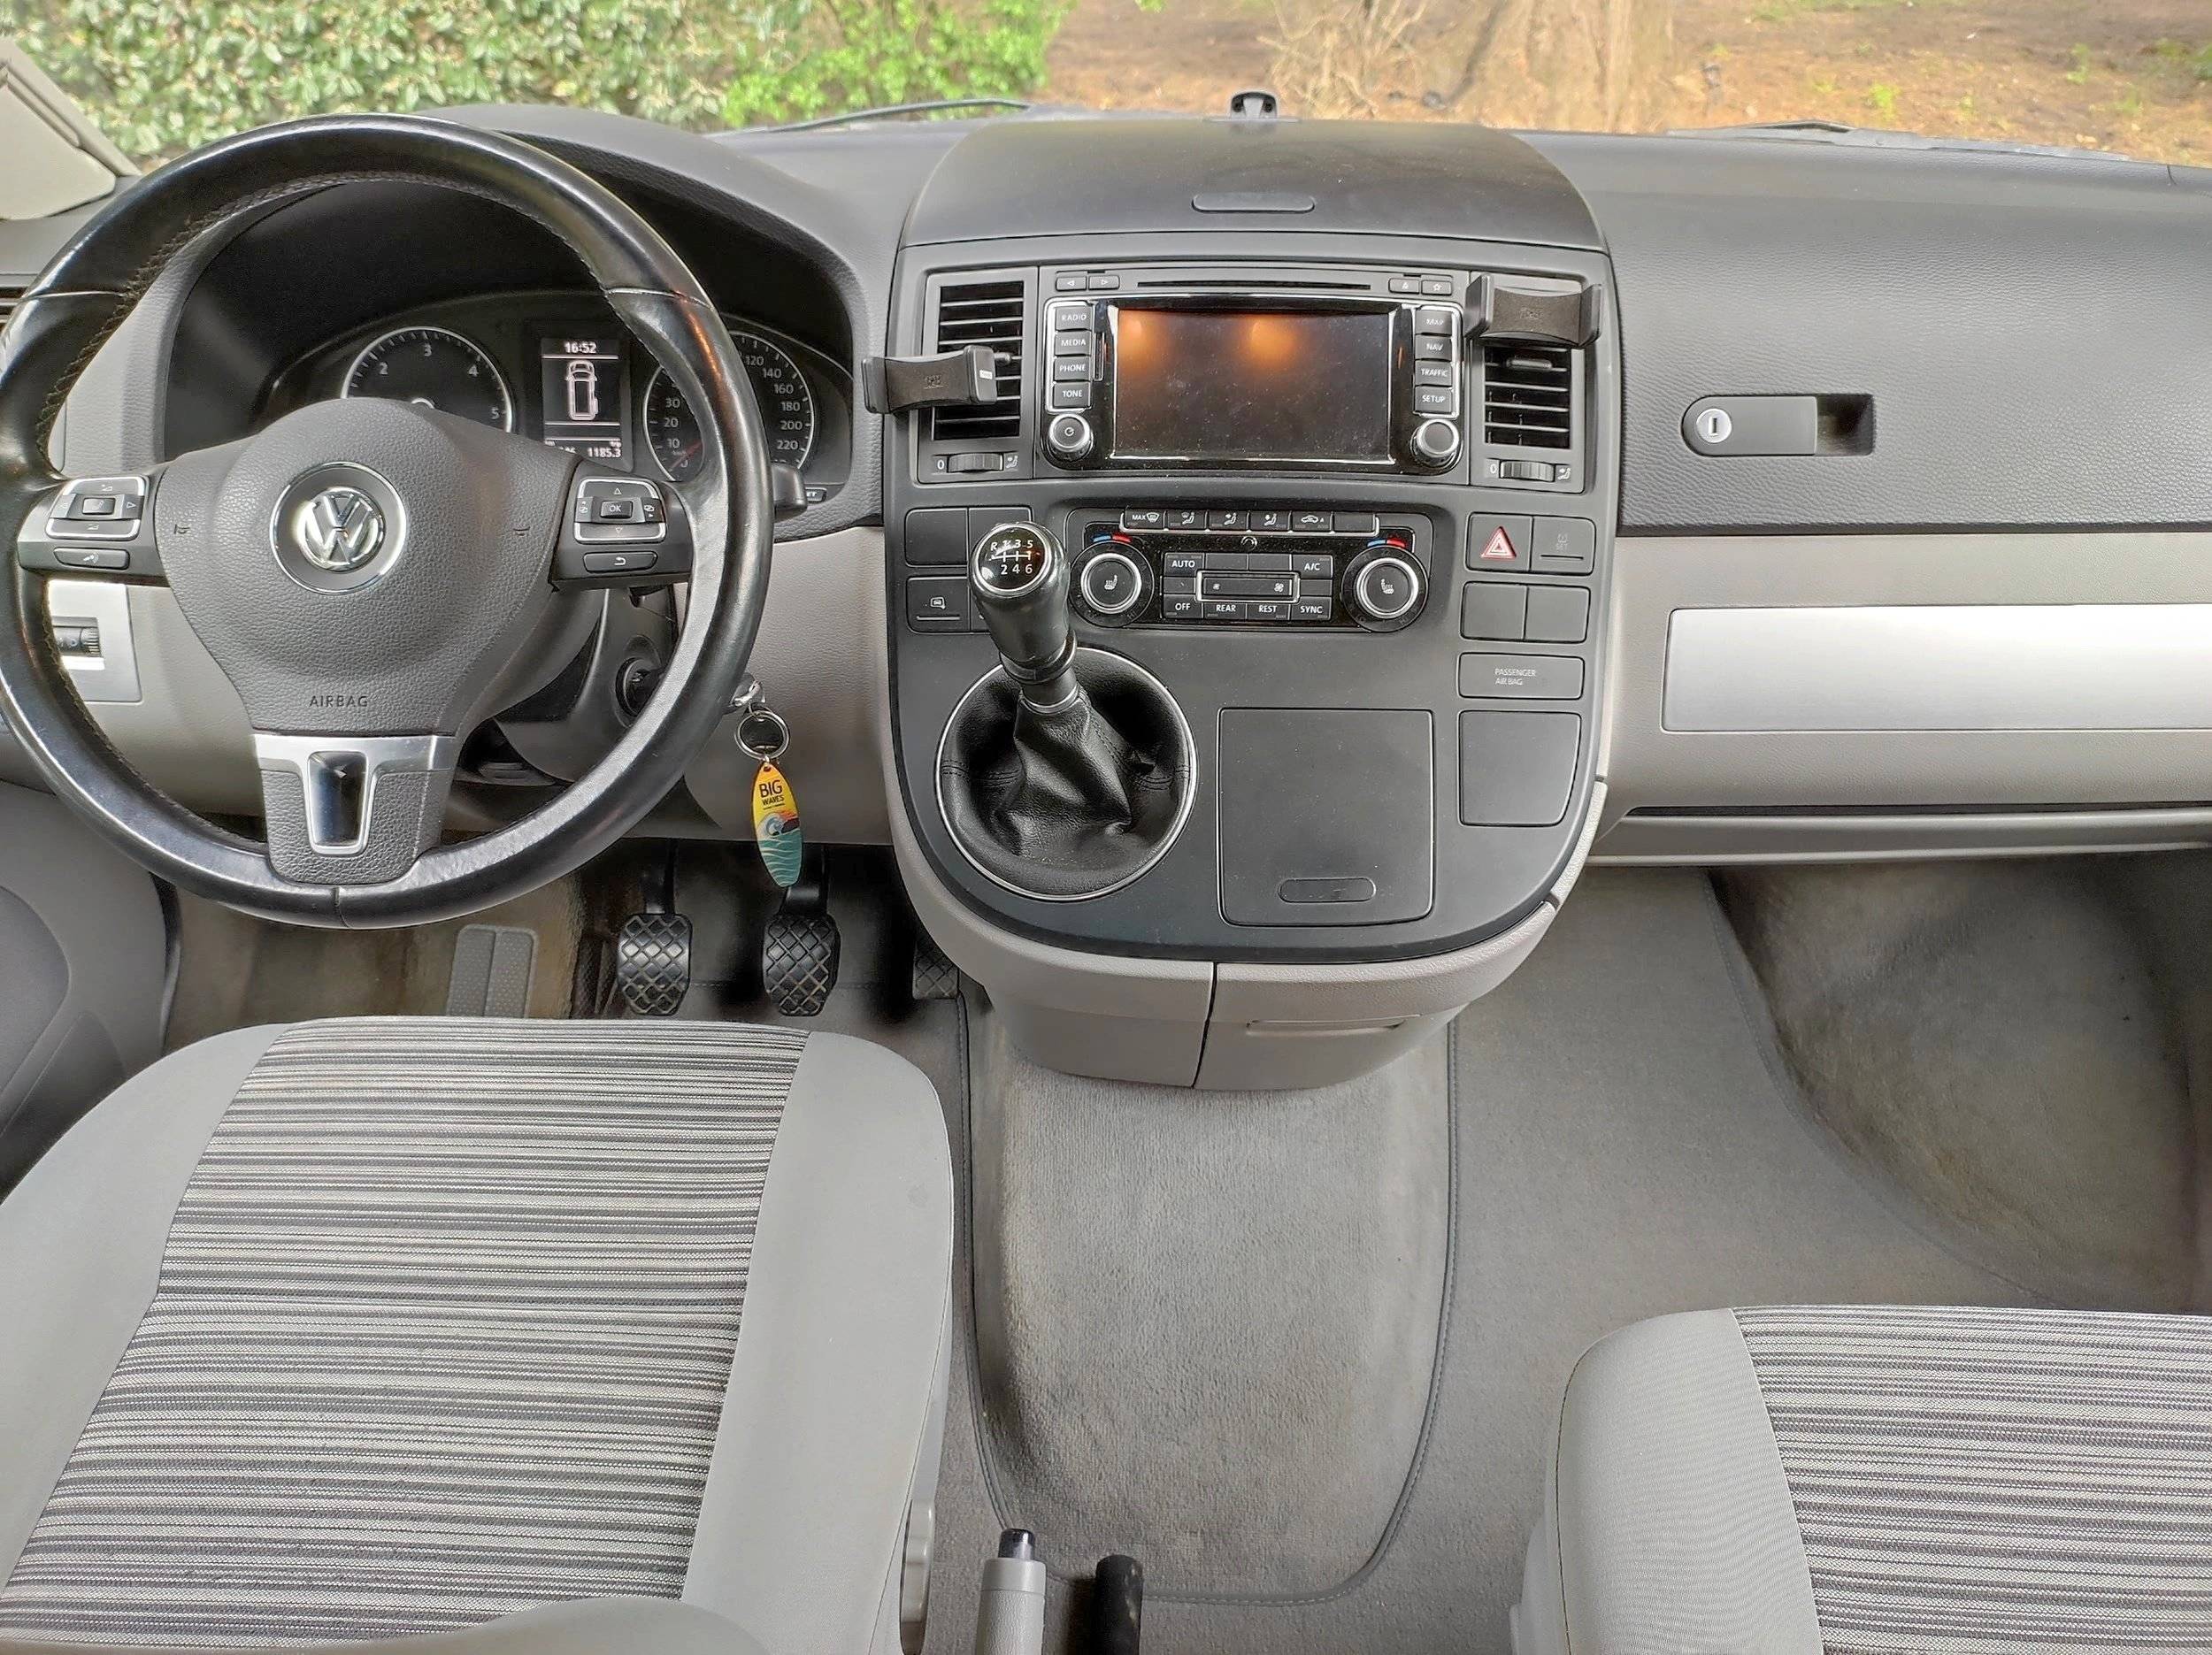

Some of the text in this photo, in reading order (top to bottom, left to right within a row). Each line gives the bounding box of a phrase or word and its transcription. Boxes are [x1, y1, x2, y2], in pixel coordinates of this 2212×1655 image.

[424, 343, 432, 356] 3
[564, 341, 597, 354] 16:52
[746, 356, 764, 366] 120
[380, 362, 388, 375] 2
[468, 364, 479, 377] 4
[762, 369, 782, 379] 140
[1421, 368, 1448, 377] TRAFFIC
[774, 384, 794, 395] 160
[665, 398, 680, 409] 30
[1422, 395, 1446, 403] SETUP
[781, 402, 801, 412] 180
[491, 407, 499, 420] 5
[664, 418, 679, 428] 20
[780, 420, 803, 431] 200
[667, 438, 680, 448] 10
[777, 440, 798, 450] 220
[609, 504, 622, 513] OK
[991, 541, 998, 551] R
[1015, 539, 1022, 548] 3
[1026, 540, 1033, 548] 5
[1001, 563, 1033, 575] 2 4 6
[1494, 668, 1536, 677] PASSENGER
[309, 694, 368, 708] AIRBAG
[759, 779, 783, 798] BIG
